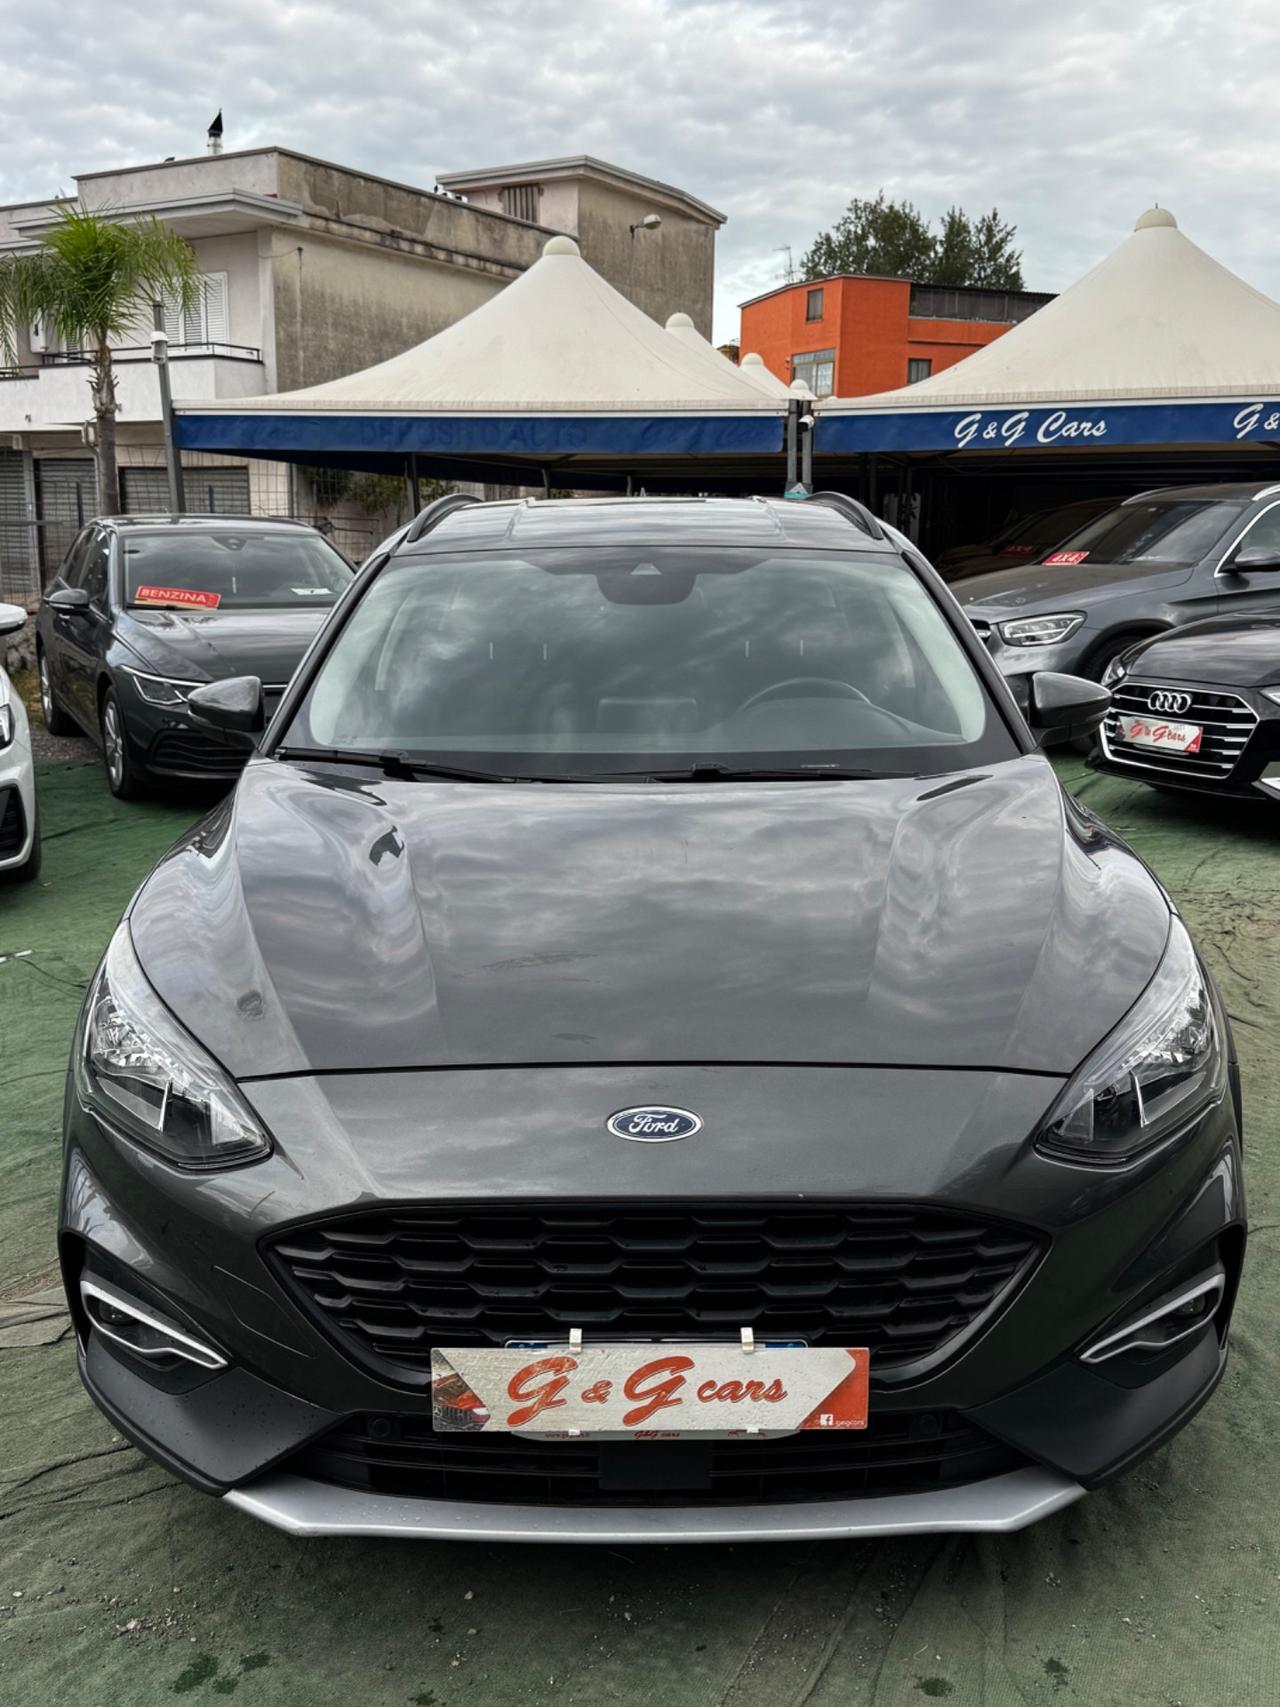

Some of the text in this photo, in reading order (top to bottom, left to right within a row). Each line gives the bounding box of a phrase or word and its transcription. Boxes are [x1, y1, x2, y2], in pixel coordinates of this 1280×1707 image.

[1036, 411, 1108, 444] Cars
[141, 588, 207, 604] BENZINA
[628, 1112, 681, 1133] Ford
[507, 1354, 788, 1428] G & G cars
